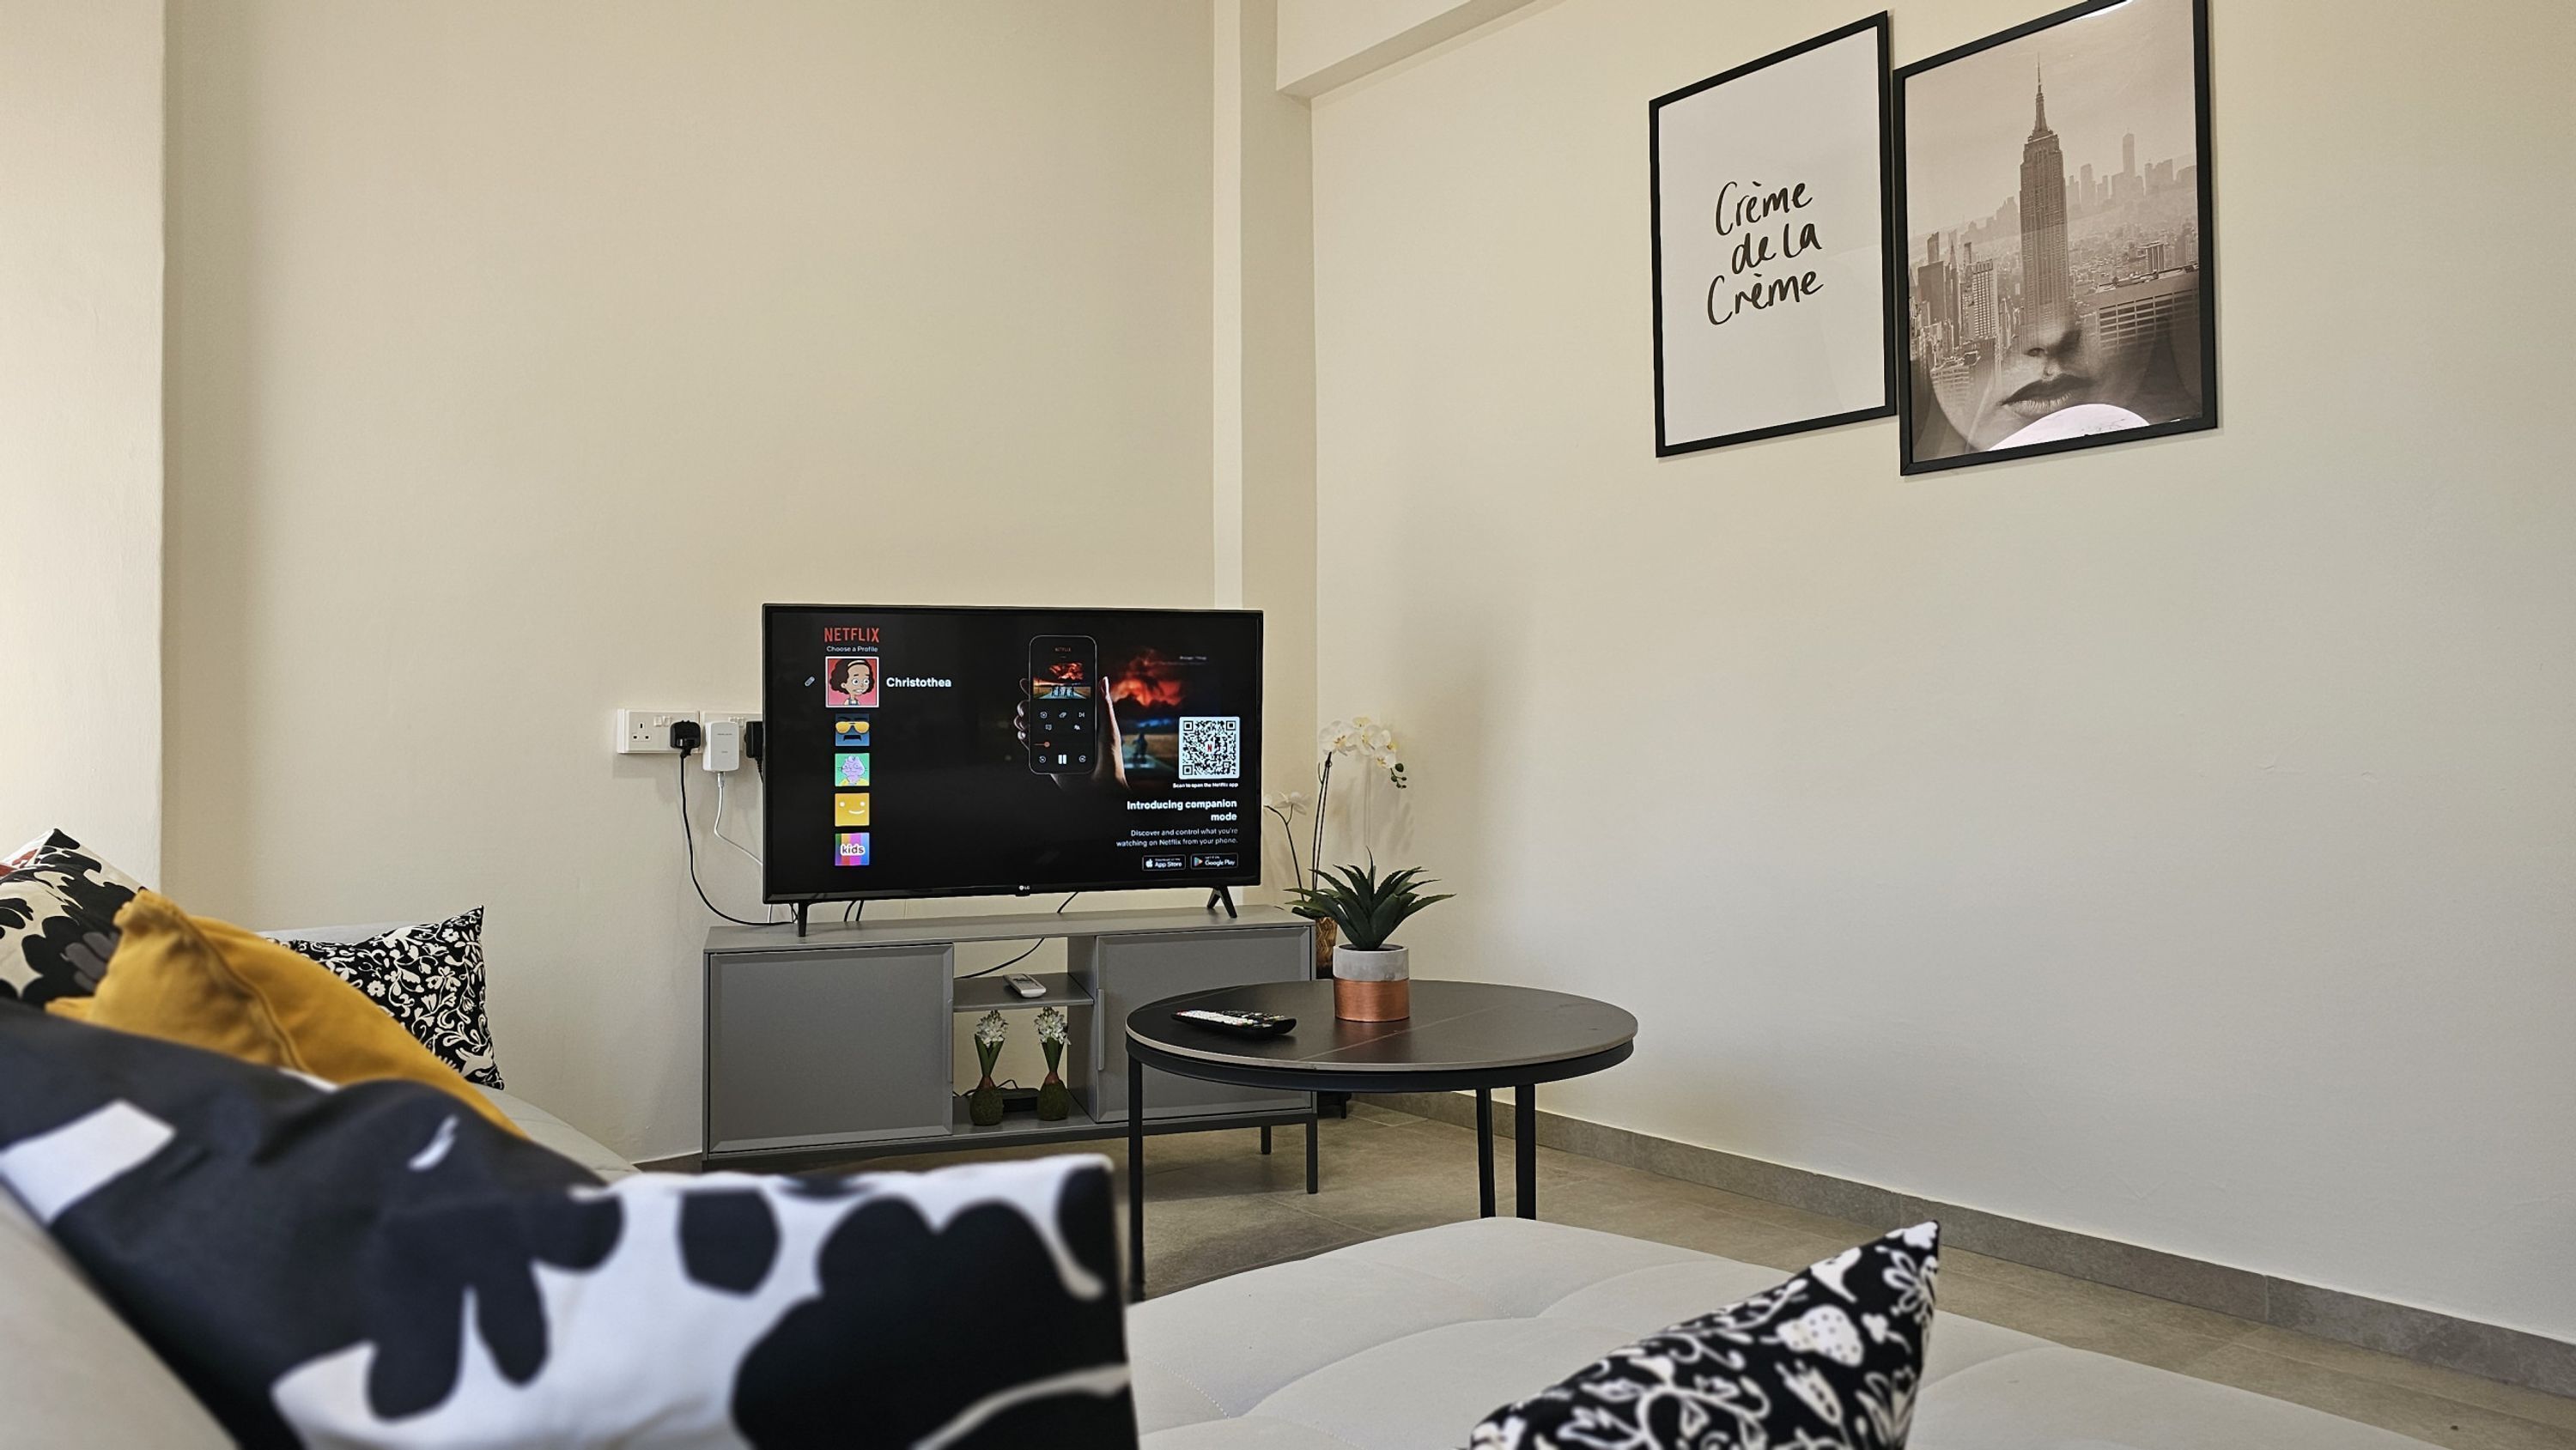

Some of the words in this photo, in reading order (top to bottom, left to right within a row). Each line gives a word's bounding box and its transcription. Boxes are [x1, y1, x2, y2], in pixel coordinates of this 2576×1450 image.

[1716, 181, 1813, 235] Crème
[1732, 233, 1777, 274] de
[1783, 223, 1822, 258] la
[1707, 271, 1824, 325] Crème
[824, 628, 879, 642] NETFLIX
[886, 677, 952, 688] Christothea
[1127, 800, 1183, 810] Introducing
[1185, 799, 1237, 810] companion
[1211, 812, 1237, 821] mode
[842, 845, 864, 854] kids
